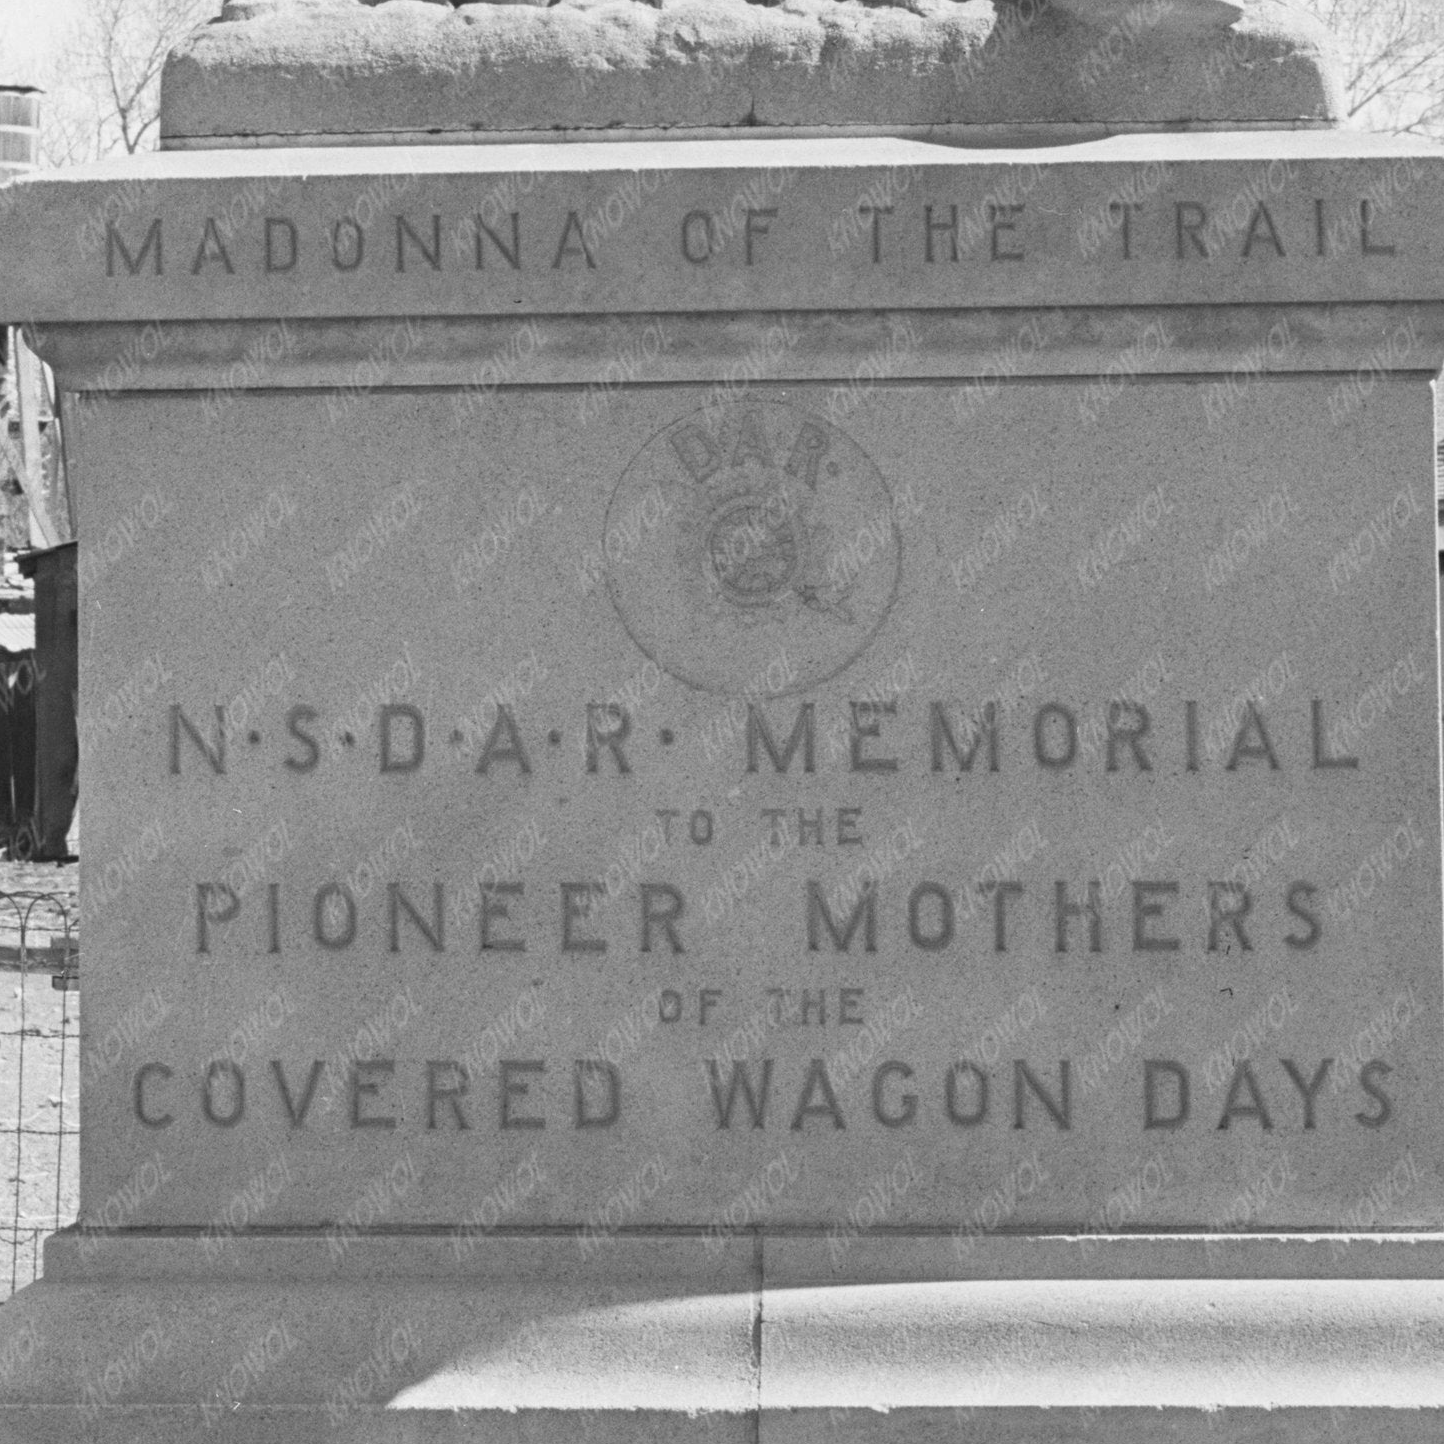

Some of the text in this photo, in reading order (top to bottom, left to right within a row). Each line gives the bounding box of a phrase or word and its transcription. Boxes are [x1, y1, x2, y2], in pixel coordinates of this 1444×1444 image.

[105, 198, 1396, 276] MADONNA OF THE TRAIL
[744, 699, 1359, 774] MEMORIAL
[656, 807, 863, 846] TO THE
[195, 880, 1323, 953] PIONEER MOTHERS
[658, 987, 864, 1025] OF THE
[132, 1059, 1394, 1130] COVERED WAGON DAYS
